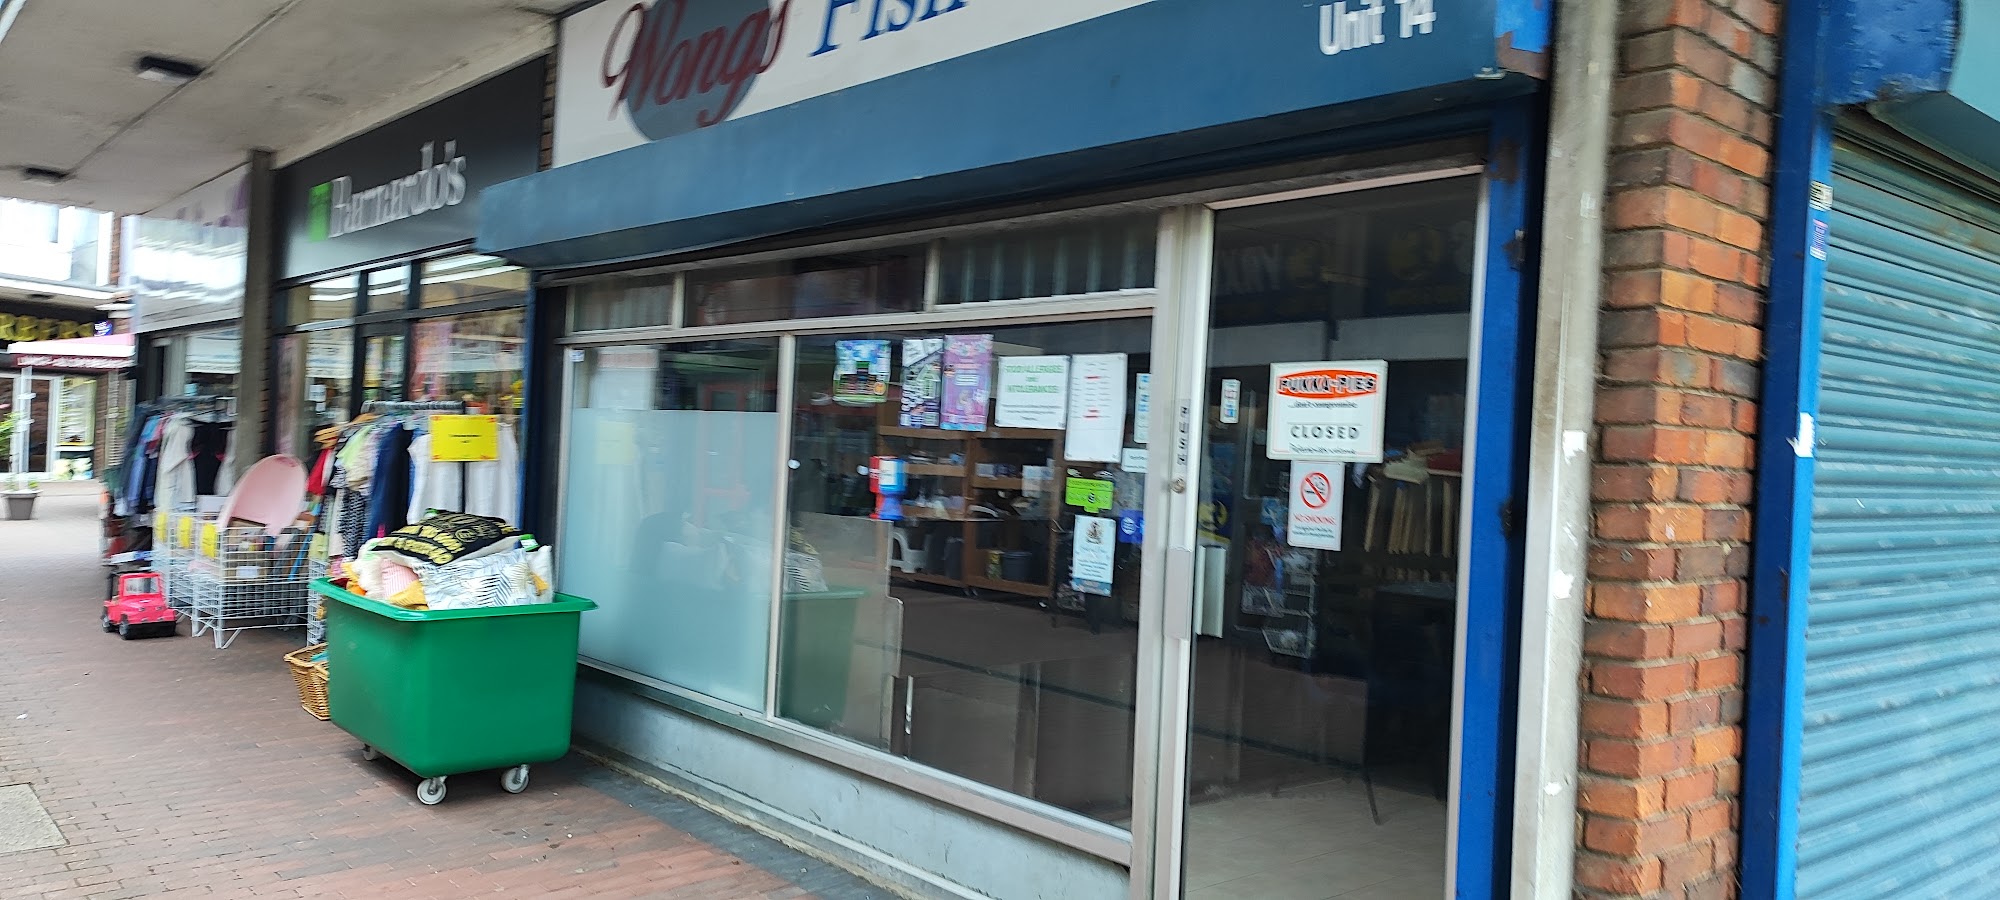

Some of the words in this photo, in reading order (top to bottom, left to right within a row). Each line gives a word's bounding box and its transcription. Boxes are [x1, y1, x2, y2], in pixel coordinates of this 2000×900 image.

[1319, 1, 1385, 55] Unit
[1396, 0, 1437, 38] 14
[1290, 425, 1360, 439] CLOSED
